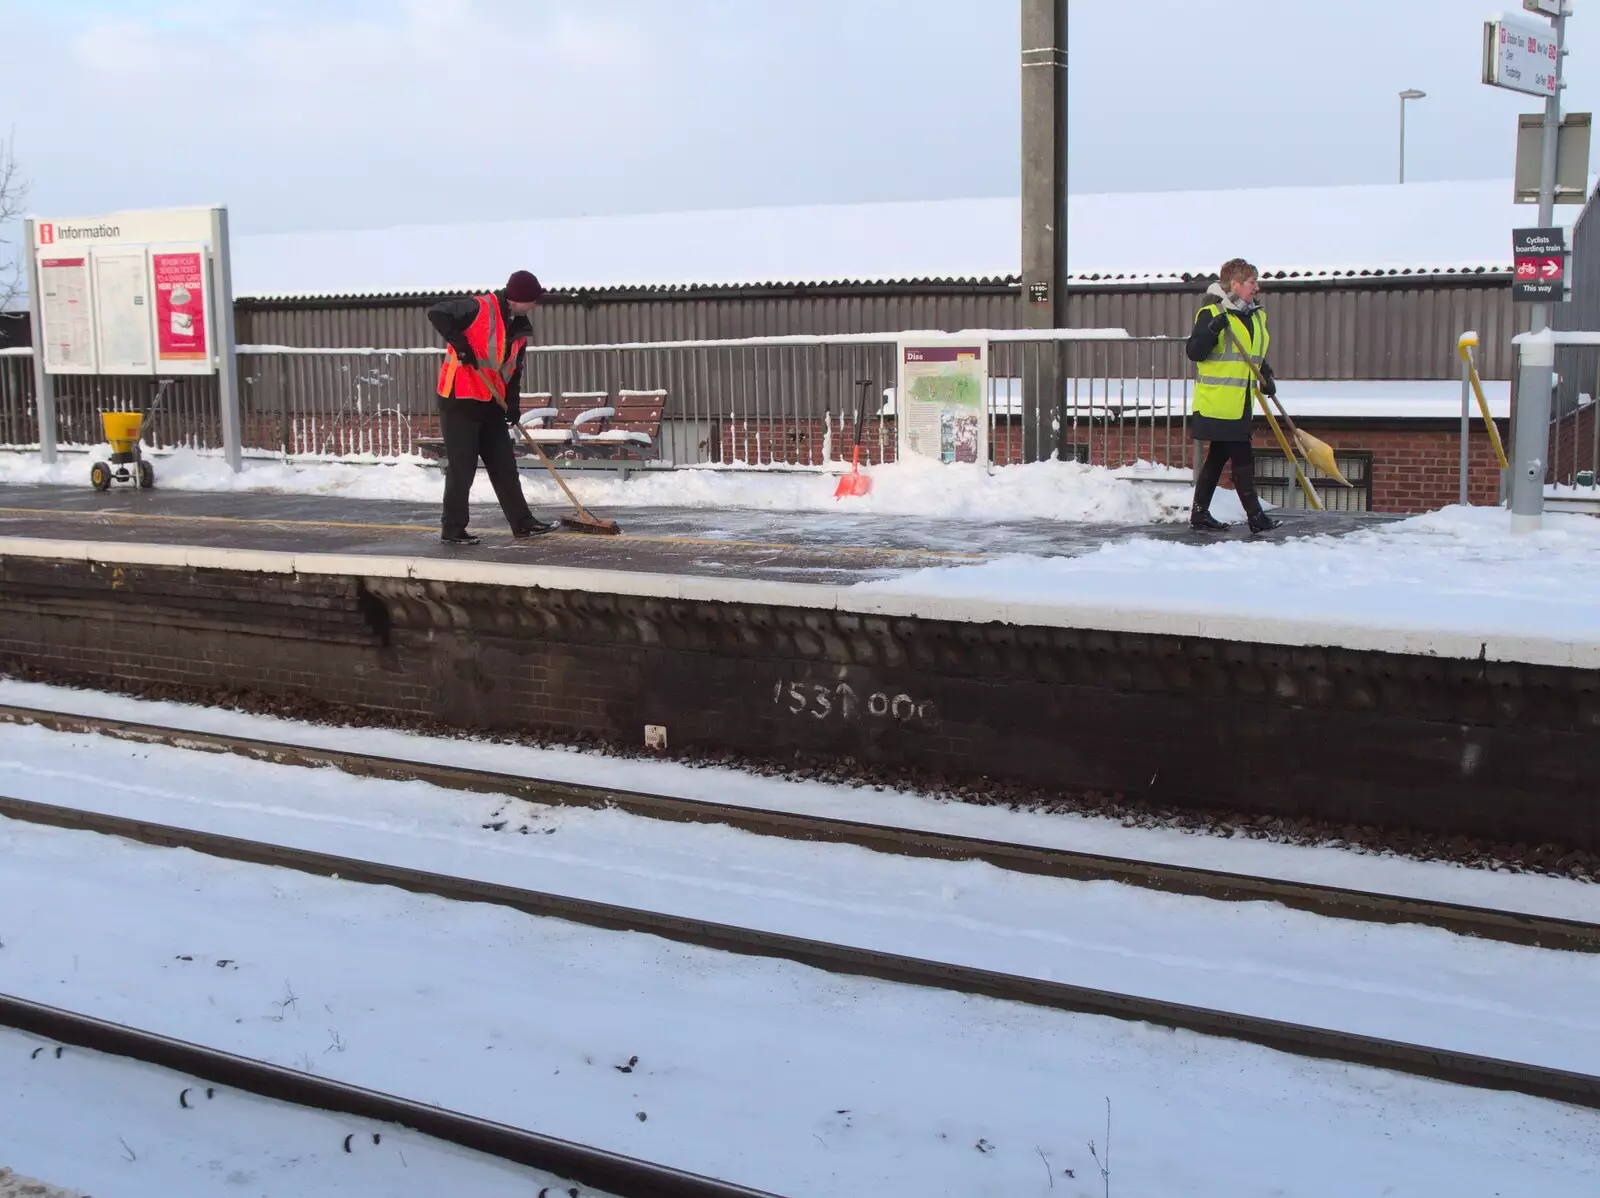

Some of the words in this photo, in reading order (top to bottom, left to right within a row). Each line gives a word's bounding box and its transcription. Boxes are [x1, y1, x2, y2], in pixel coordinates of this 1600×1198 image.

[58, 224, 120, 240] Information
[1526, 236, 1550, 246] Cyclists
[1516, 245, 1544, 254] boarding
